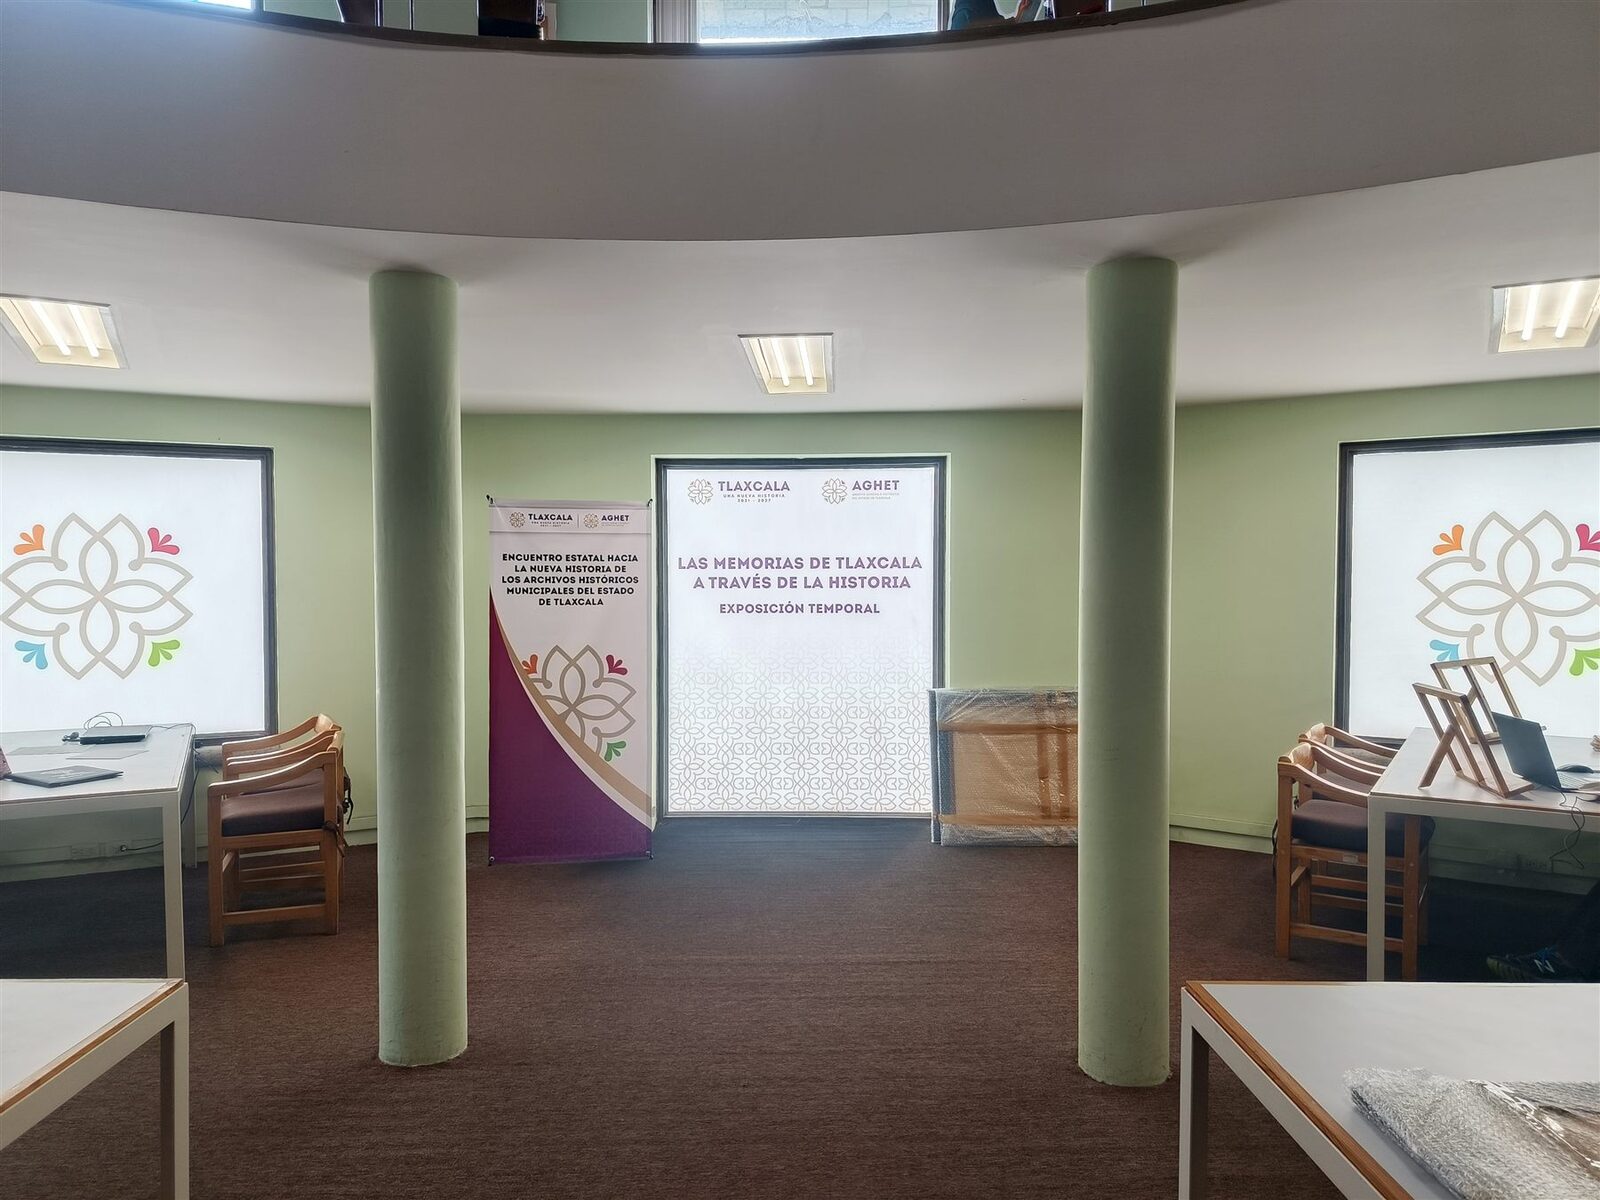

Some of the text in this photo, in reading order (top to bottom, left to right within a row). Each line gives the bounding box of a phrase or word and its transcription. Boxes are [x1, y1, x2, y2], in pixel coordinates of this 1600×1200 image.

[718, 481, 790, 491] TLAXCALA
[852, 480, 899, 490] AGHET
[503, 554, 562, 562] ENCUENTRO
[679, 557, 922, 569] LAS MEMORIAS DE TLAXCALA
[515, 565, 527, 573] LA
[530, 565, 562, 573] NUEVA
[502, 575, 638, 584] LOS ARCHIVOS HISTÓRICOS
[693, 573, 910, 588] A TRAVÉS DE LA HISTORIA
[507, 587, 574, 595] MUNICIPALES
[598, 587, 634, 595] ESTADO
[720, 601, 880, 613] EXPOSICIÓN TEMPORAL
